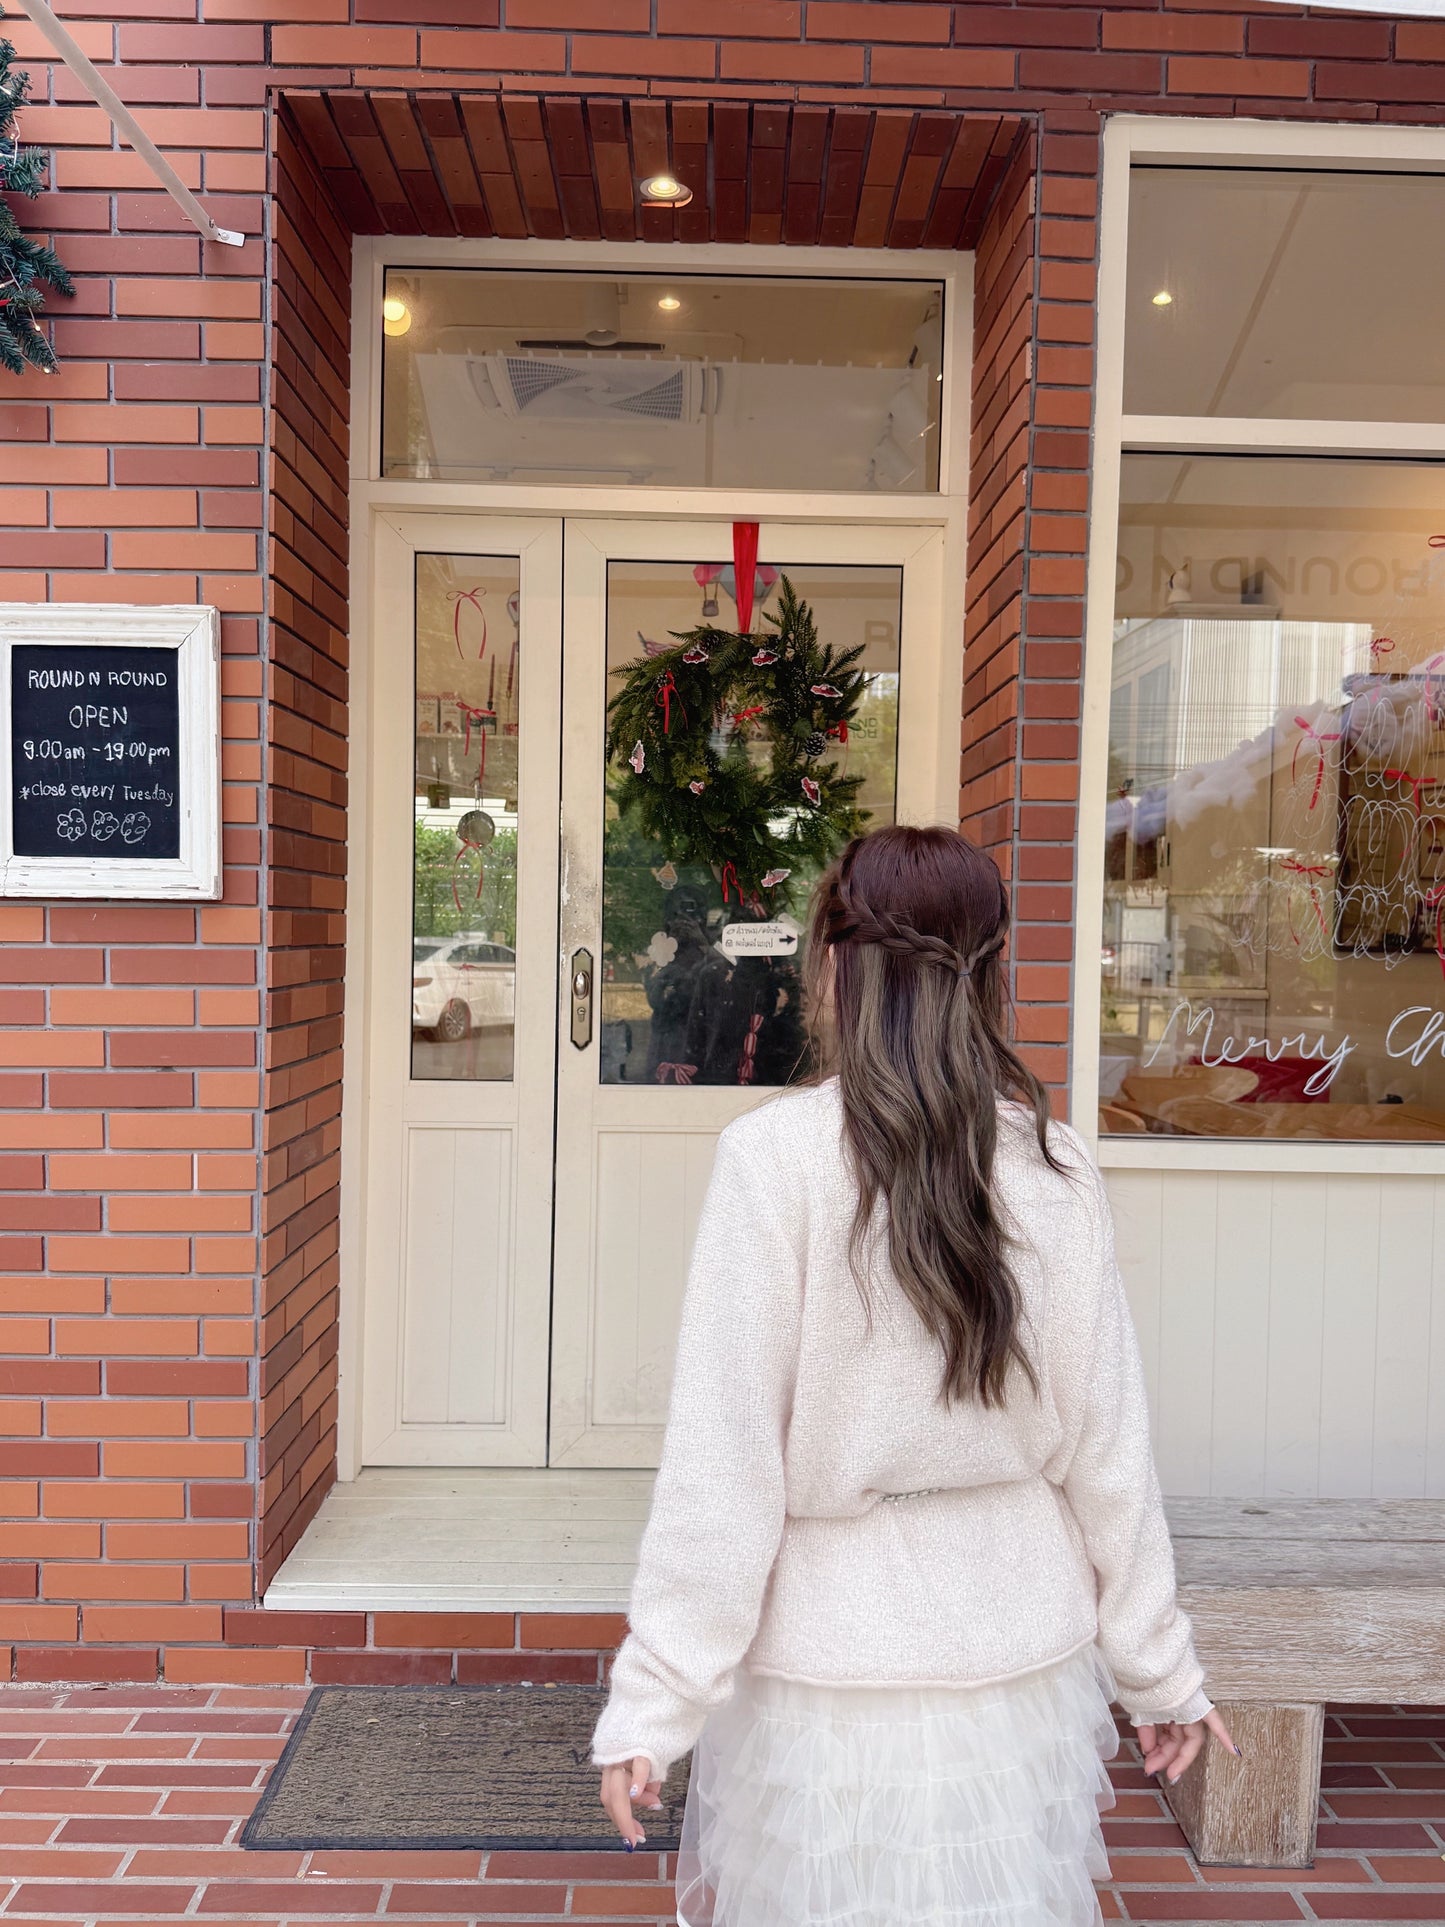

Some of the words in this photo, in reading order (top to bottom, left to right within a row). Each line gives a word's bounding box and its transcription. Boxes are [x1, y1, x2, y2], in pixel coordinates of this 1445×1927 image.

[28, 669, 84, 689] ROUND
[89, 671, 100, 687] N
[108, 671, 167, 687] ROUND
[69, 704, 128, 729] OPEN
[23, 739, 85, 760] 9.00am
[71, 784, 115, 800] every
[123, 783, 173, 807] Tuesday
[1143, 1001, 1358, 1095] Merry
